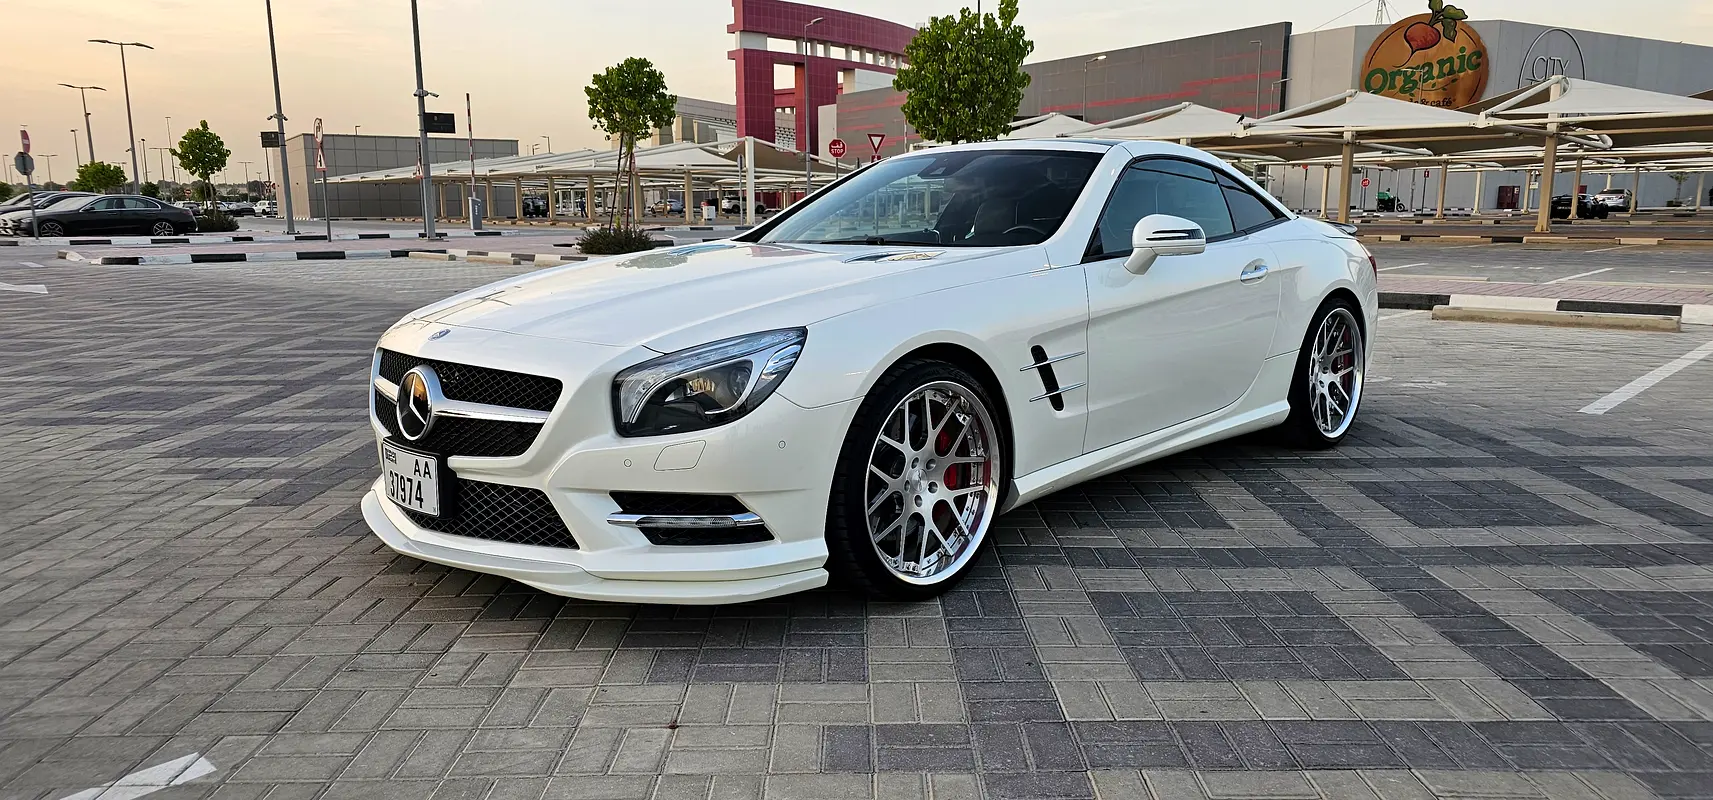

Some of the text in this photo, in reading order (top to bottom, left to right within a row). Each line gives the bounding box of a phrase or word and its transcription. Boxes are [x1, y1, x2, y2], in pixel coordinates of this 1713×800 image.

[1364, 46, 1482, 94] Organic
[1532, 56, 1570, 81] CITY
[1430, 97, 1452, 107] café
[413, 458, 432, 479] AA
[389, 469, 424, 509] 37974
